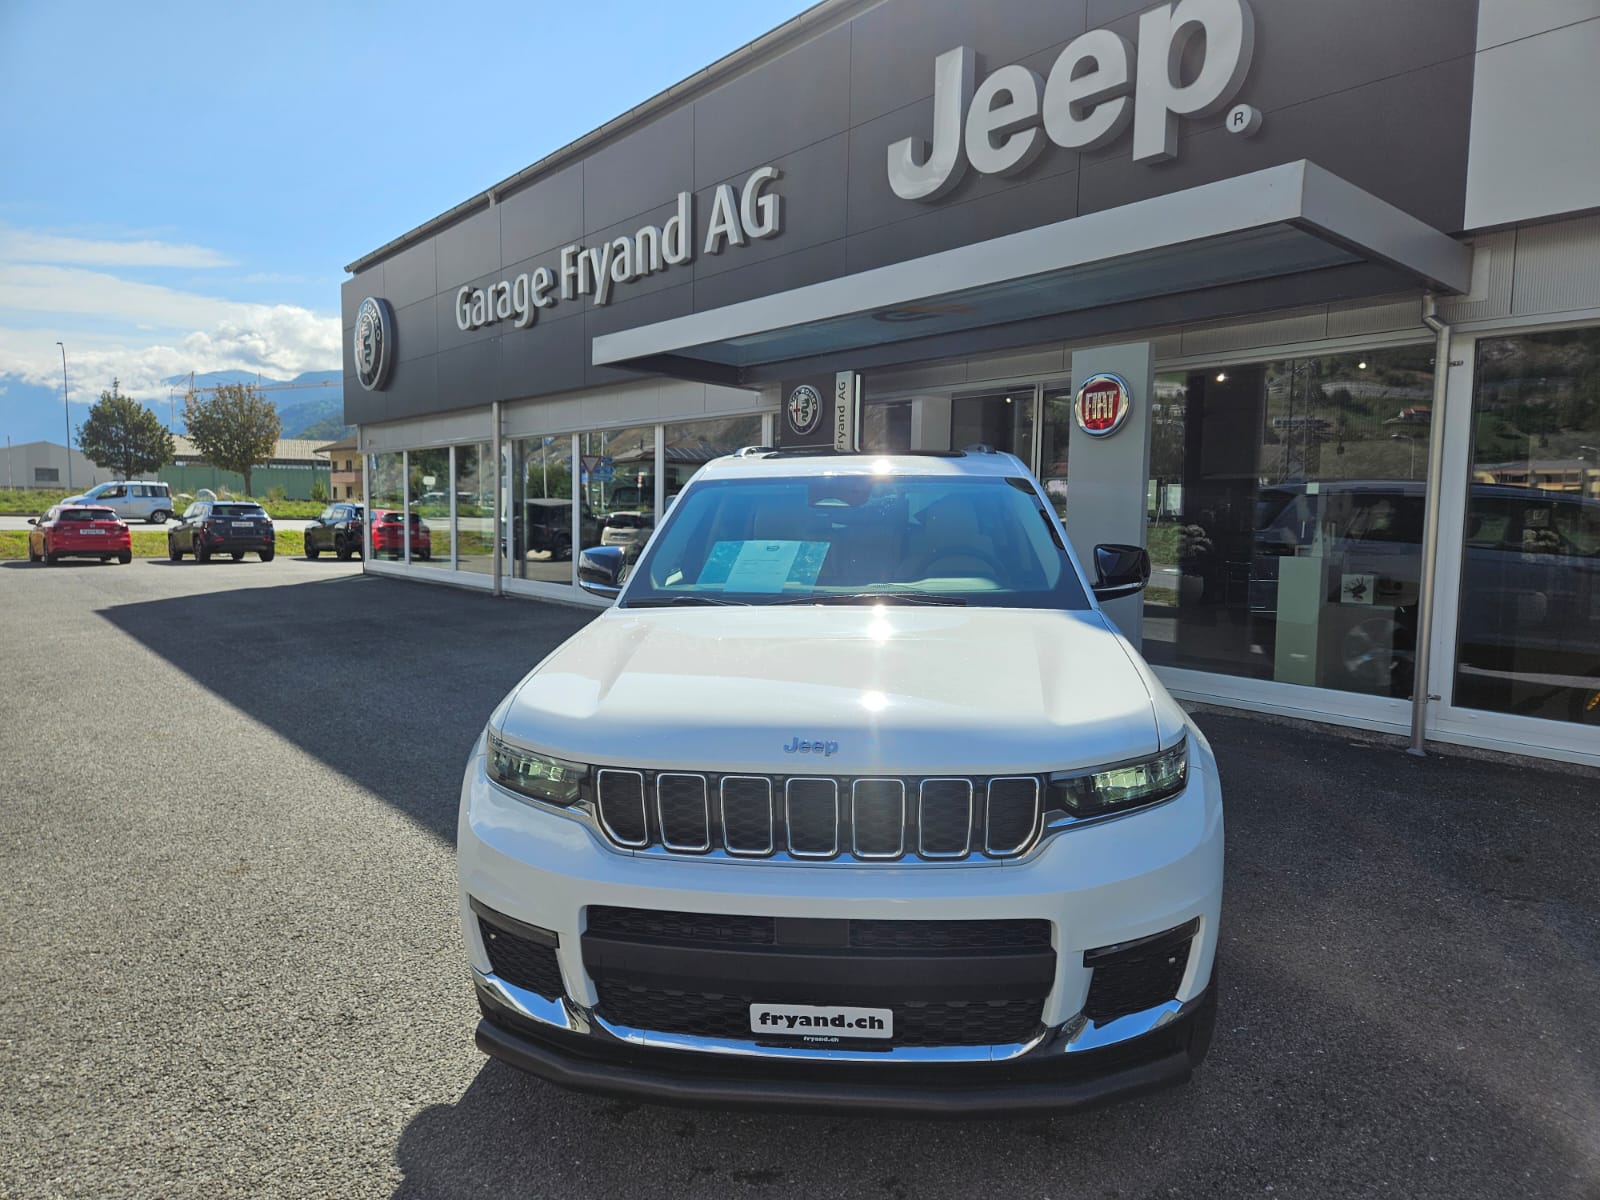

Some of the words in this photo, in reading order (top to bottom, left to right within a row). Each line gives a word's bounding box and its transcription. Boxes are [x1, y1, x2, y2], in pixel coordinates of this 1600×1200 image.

[887, 0, 1253, 201] Jeep
[455, 266, 554, 331] Garage
[561, 191, 692, 306] Fryand
[704, 166, 779, 255] AG
[839, 382, 846, 400] AG
[1085, 390, 1118, 421] FIAT
[837, 405, 847, 450] Fryand
[783, 736, 839, 757] Jeep
[759, 1012, 884, 1030] fryand.ch
